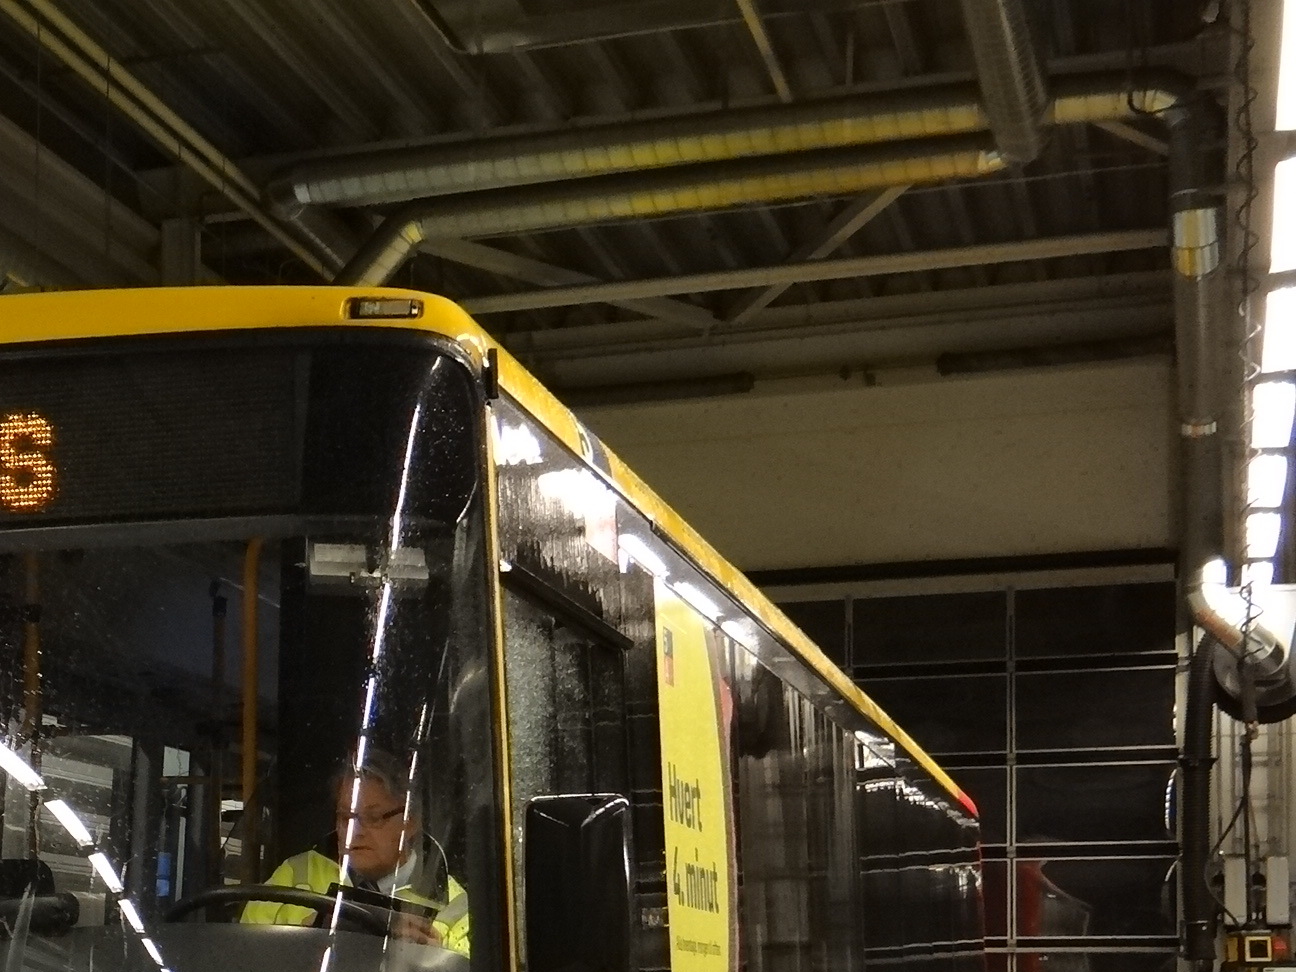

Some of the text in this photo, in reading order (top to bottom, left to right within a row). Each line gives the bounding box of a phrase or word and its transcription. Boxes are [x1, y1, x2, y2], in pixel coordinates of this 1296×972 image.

[667, 761, 703, 832] Hvert
[673, 846, 720, 914] 4. minut
